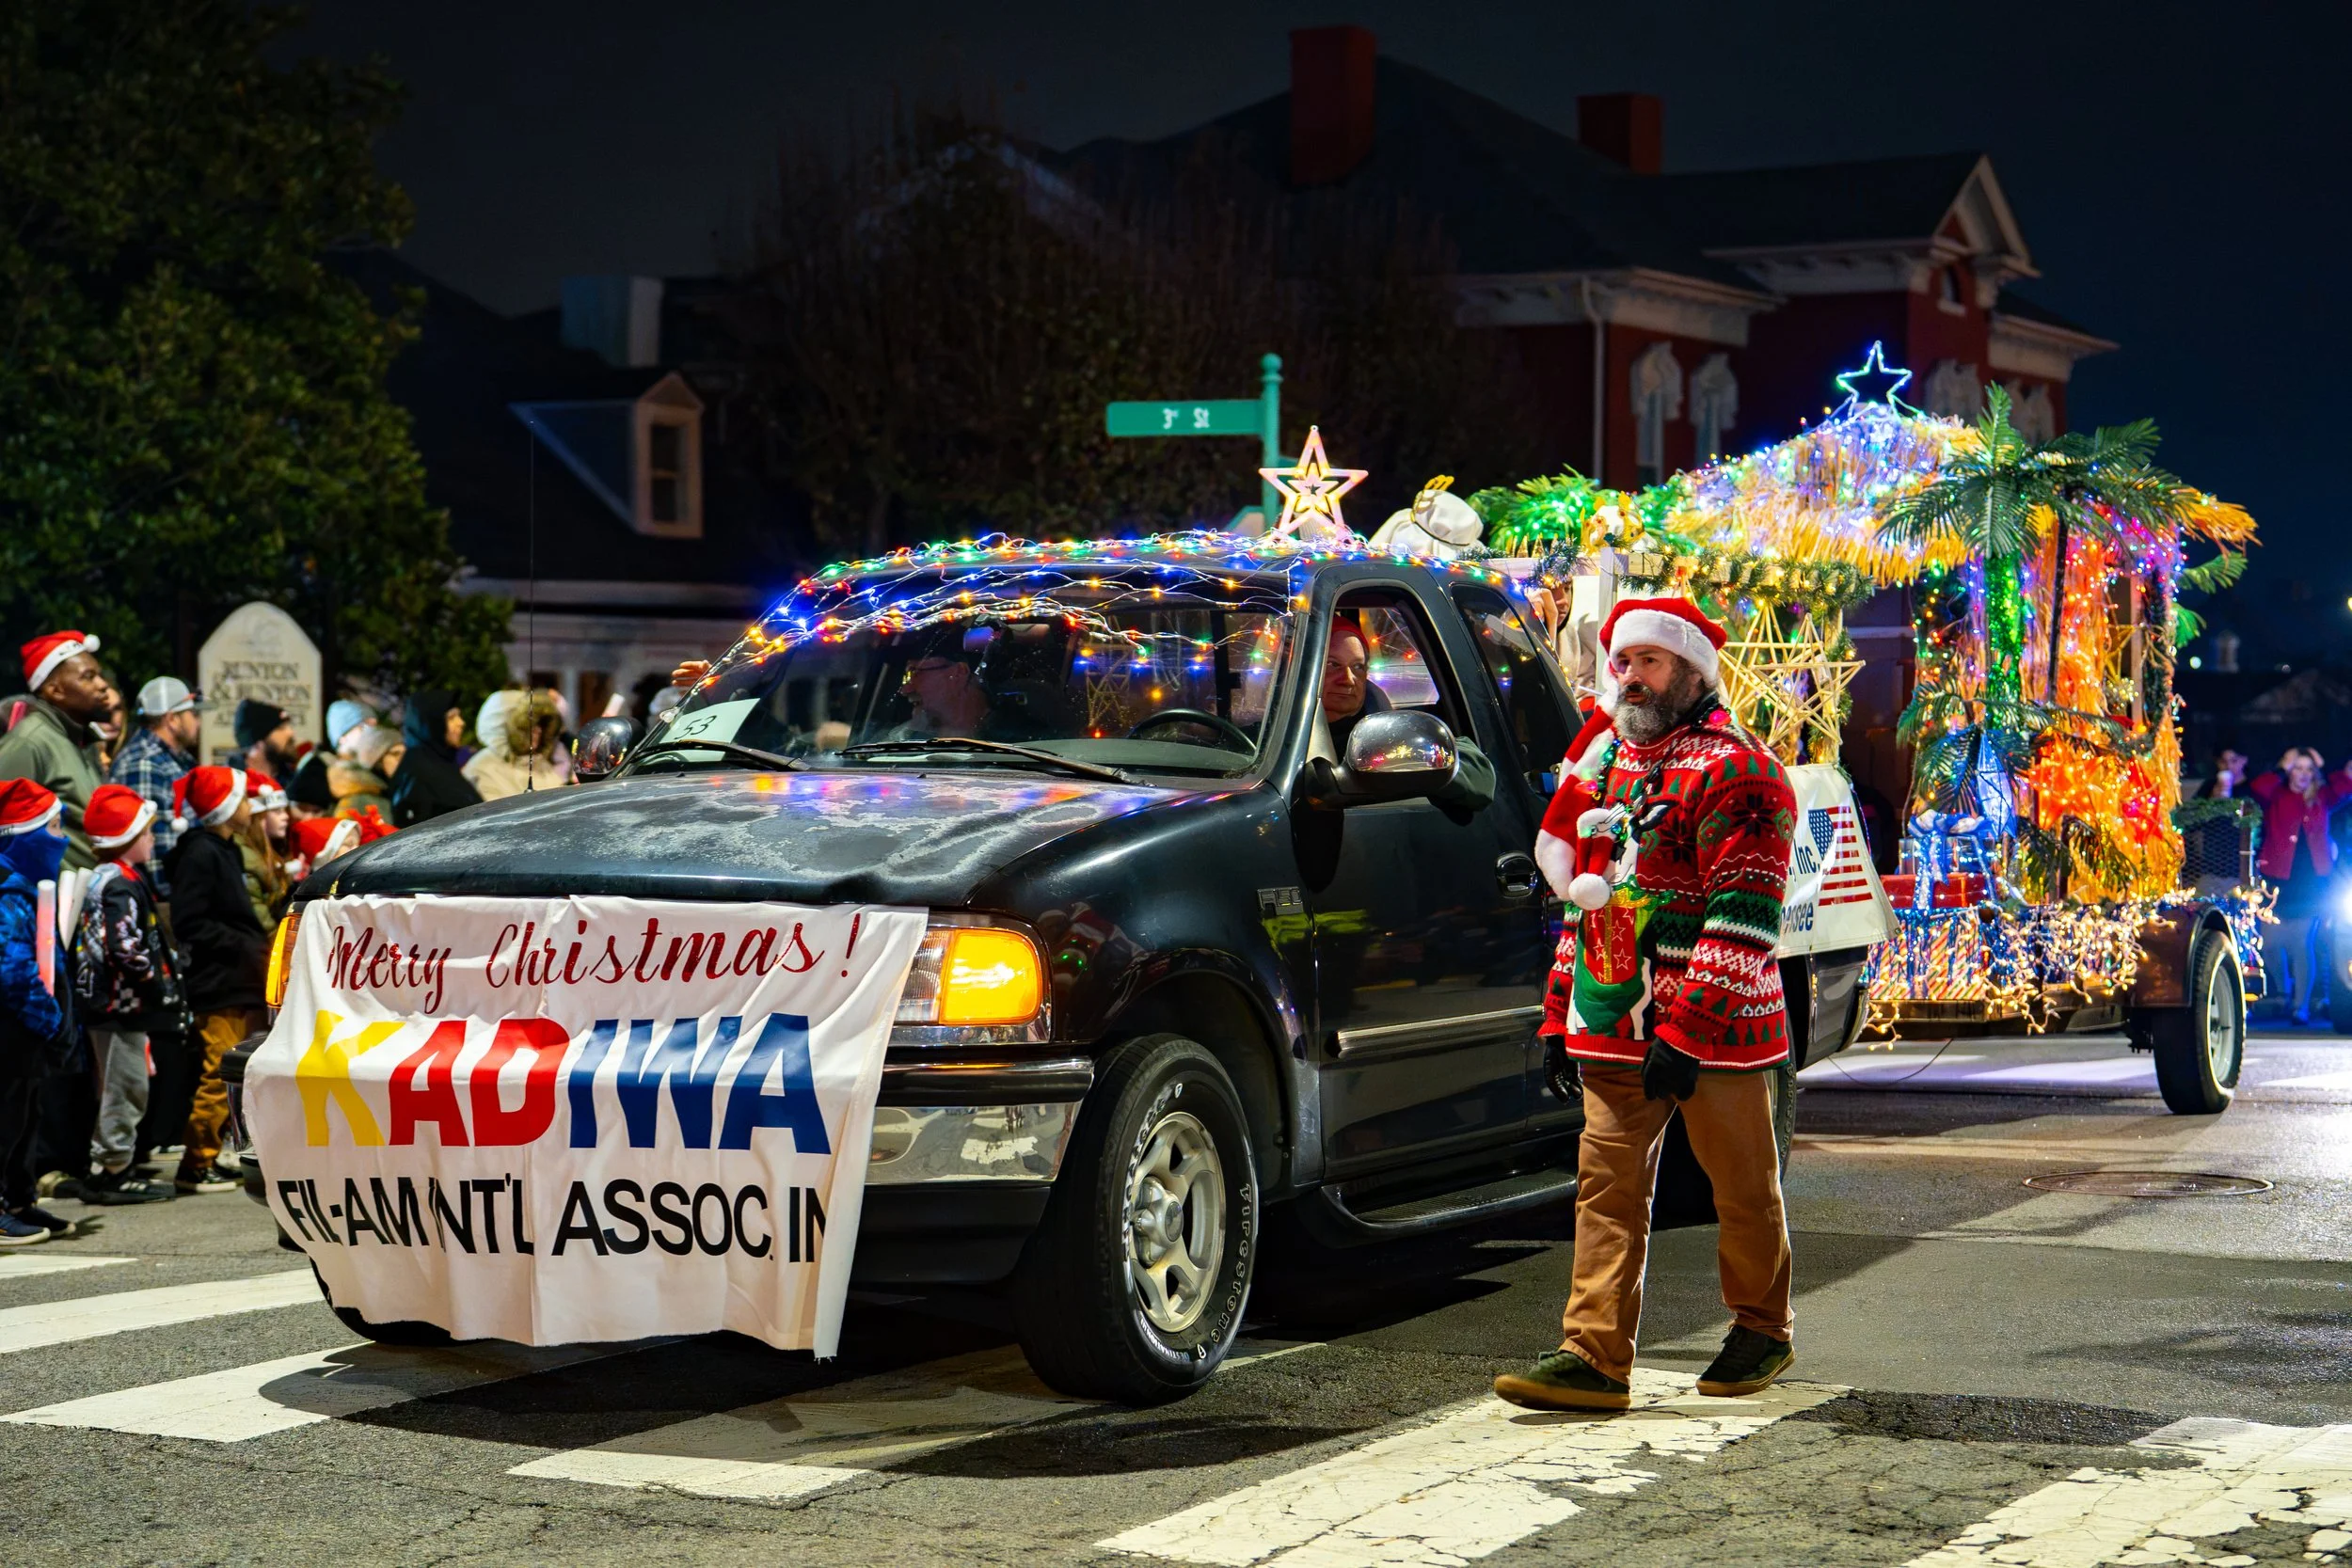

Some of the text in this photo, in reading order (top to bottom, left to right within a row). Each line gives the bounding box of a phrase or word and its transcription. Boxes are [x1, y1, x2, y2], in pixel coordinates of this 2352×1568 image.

[674, 715, 717, 740] 53
[1793, 838, 1820, 875] Inc.
[326, 926, 452, 1014] Merry
[295, 1011, 832, 1154] KADIWA
[1211, 1183, 1252, 1343] Firestone
